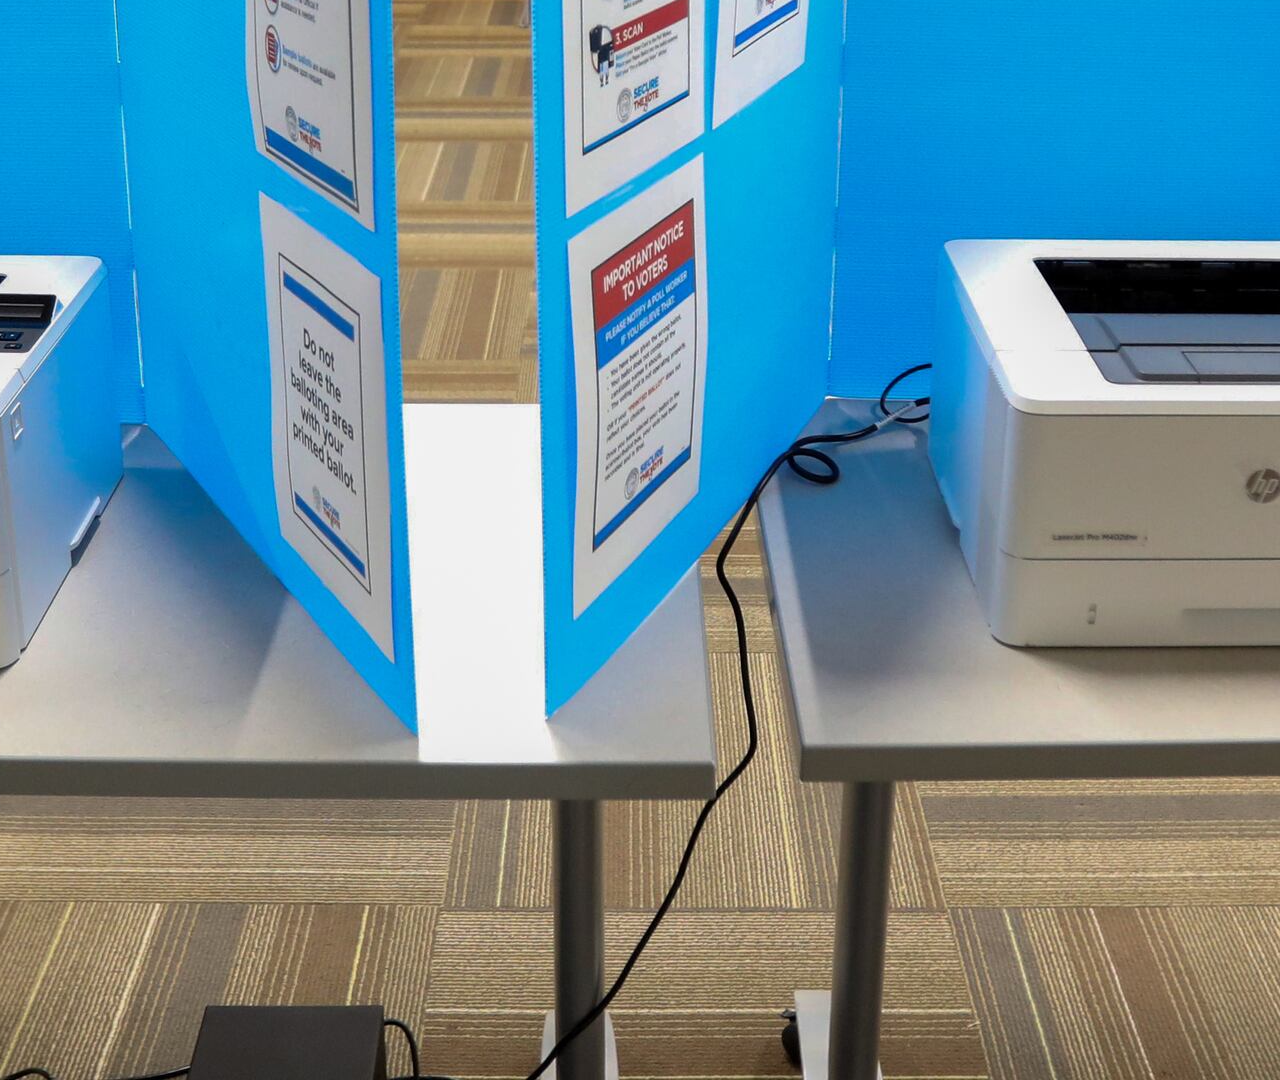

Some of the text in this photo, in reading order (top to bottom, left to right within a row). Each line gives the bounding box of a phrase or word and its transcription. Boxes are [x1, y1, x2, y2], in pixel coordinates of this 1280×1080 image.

[623, 21, 644, 42] SCAN
[633, 76, 659, 99] SECURE
[603, 220, 684, 294] IMPORTANT NOTICE
[622, 255, 668, 302] TO VOTERS
[605, 270, 688, 343] PLEASE NOTIFY A POLL WORKER
[303, 327, 335, 372] Do not
[627, 324, 640, 340] YOU
[298, 349, 341, 403] leave the
[291, 366, 354, 440] balloting area
[301, 405, 344, 457] with your
[293, 422, 357, 495] printed ballot.
[1250, 469, 1280, 504] hp
